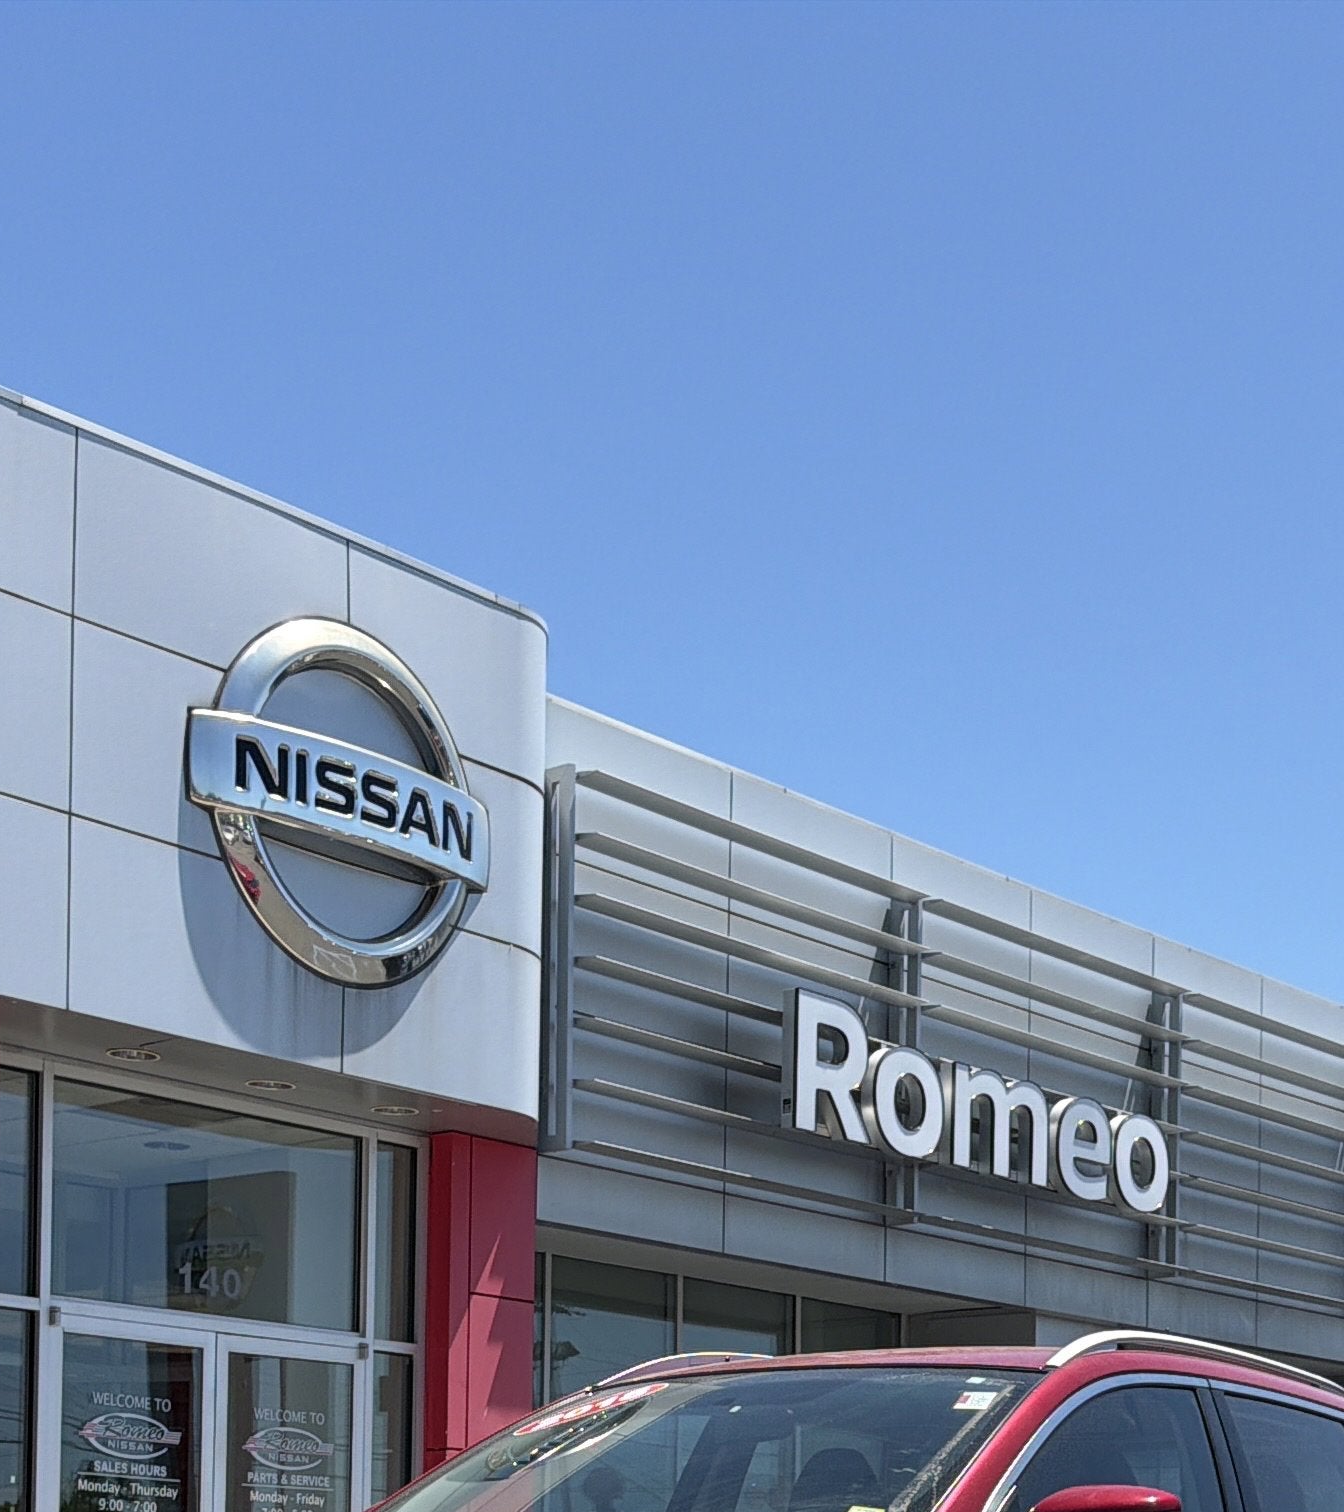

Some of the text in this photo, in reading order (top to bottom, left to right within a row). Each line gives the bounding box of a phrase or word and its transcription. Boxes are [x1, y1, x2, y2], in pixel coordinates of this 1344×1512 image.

[234, 734, 474, 863] NISSAN
[784, 986, 1170, 1213] Romeo
[92, 1391, 172, 1412] WELCOME TO
[254, 1407, 325, 1425] WELCOME TO
[98, 1415, 165, 1440] Romeo
[107, 1440, 154, 1452] NISSAN
[264, 1431, 320, 1452] Romeo
[268, 1453, 310, 1463] NISSAN
[93, 1460, 168, 1477] SALES HOURS
[247, 1472, 330, 1487] PARTS & SERVICE
[77, 1478, 121, 1496] Monday
[130, 1482, 179, 1500] Thursday
[98, 1498, 124, 1511] 9:00
[249, 1490, 288, 1505] Monday
[296, 1493, 325, 1508] Friday
